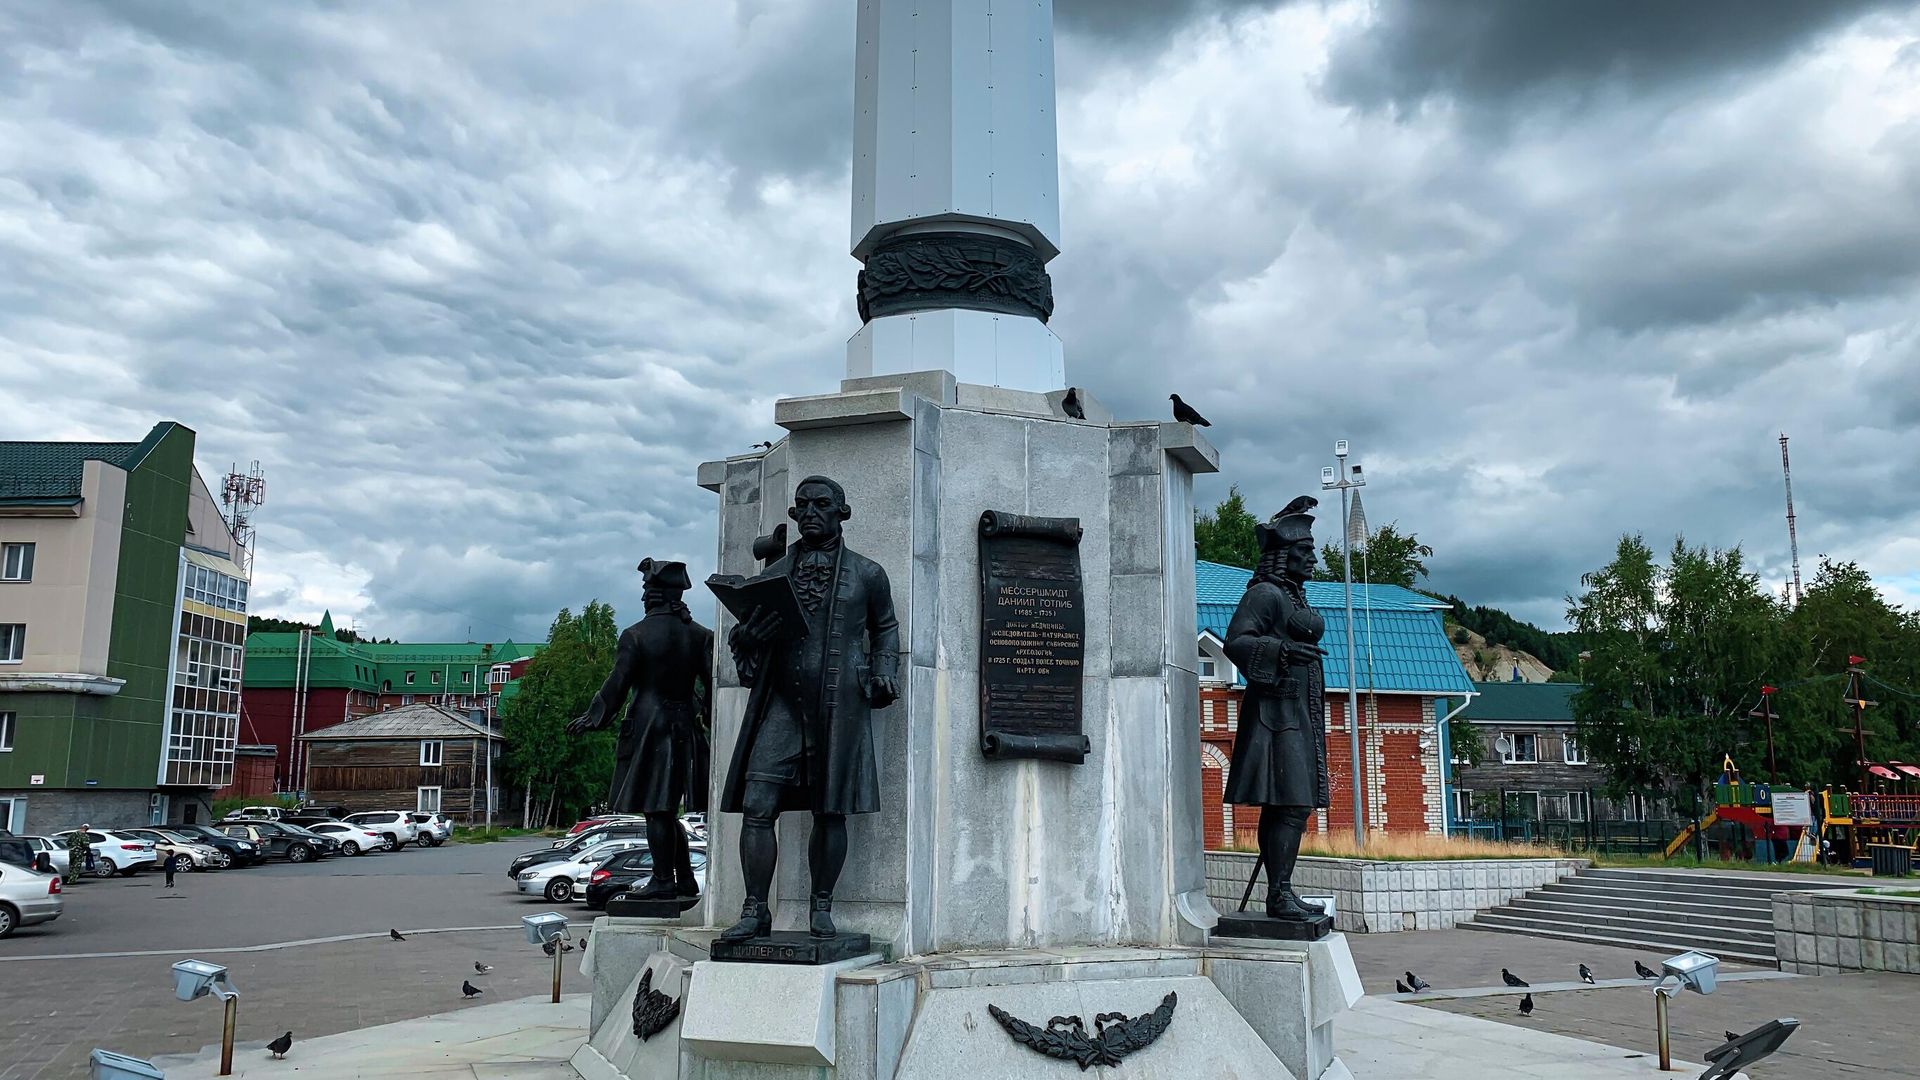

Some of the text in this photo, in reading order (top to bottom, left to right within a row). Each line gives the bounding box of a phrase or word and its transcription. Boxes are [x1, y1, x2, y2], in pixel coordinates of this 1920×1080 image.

[1000, 587, 1068, 597] МЕССЕРШМИДТ
[998, 597, 1073, 609] ДАНИИЛ ГОТЛИБ
[733, 946, 774, 957] МИЛЛЕР
